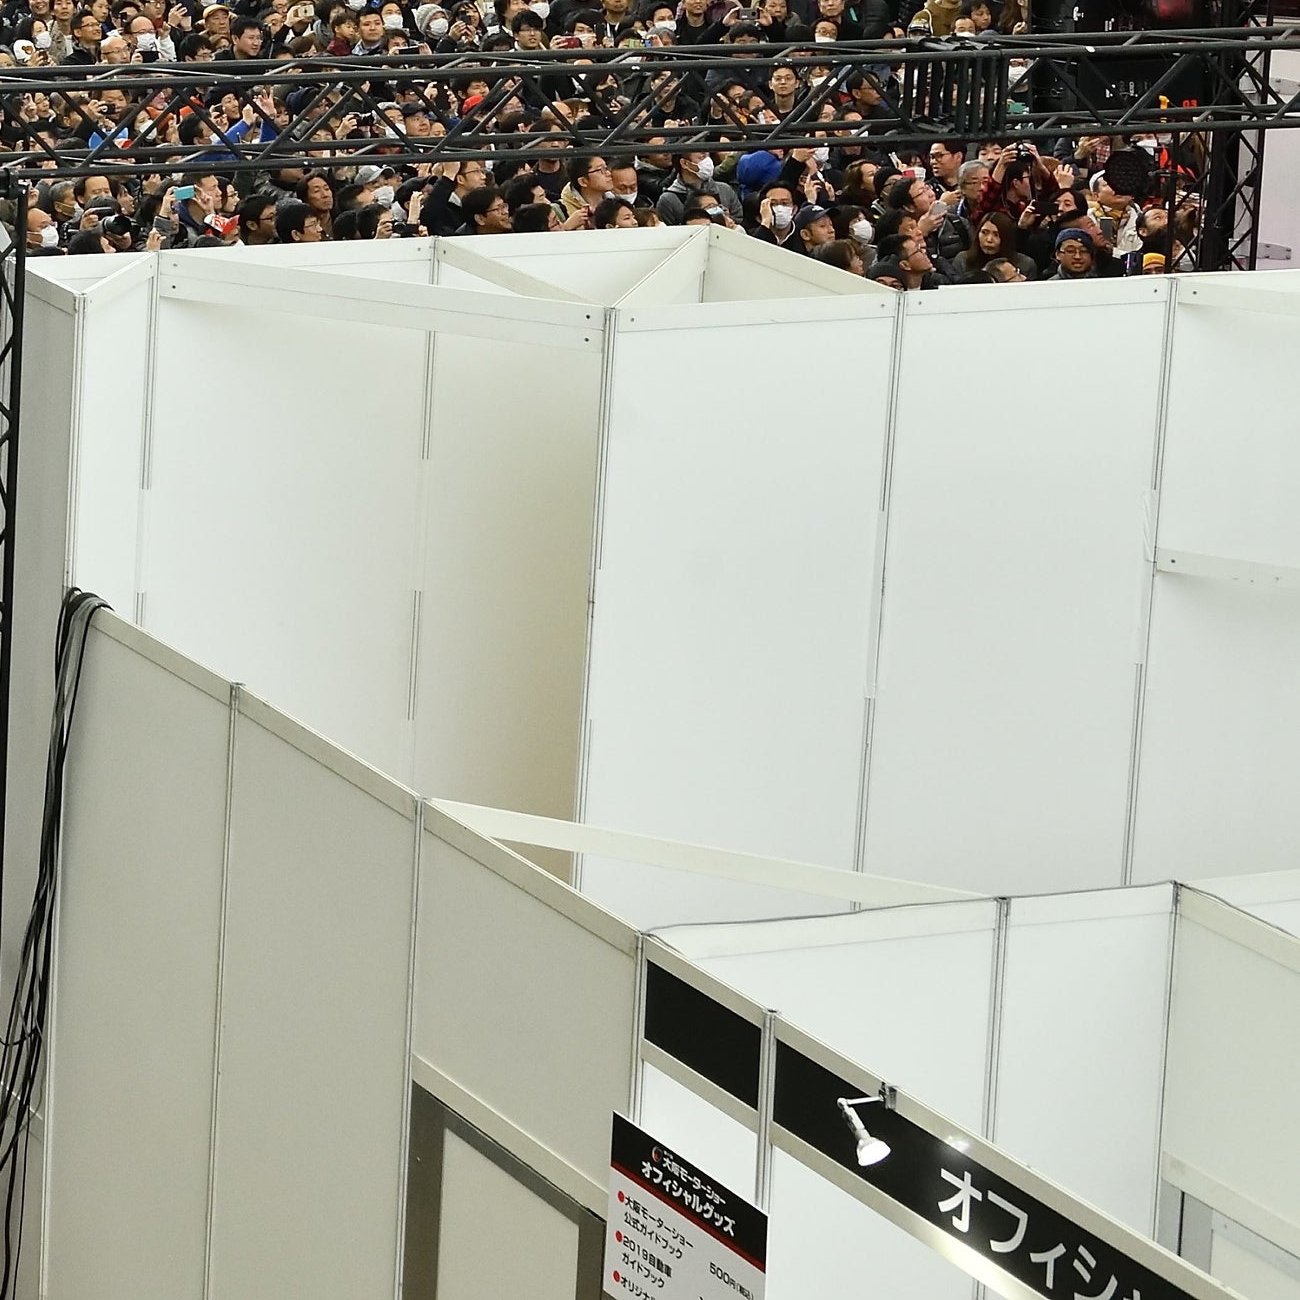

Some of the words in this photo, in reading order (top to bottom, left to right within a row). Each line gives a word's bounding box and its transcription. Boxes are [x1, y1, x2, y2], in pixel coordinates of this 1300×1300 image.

[641, 1160, 736, 1238] オフィシャルグッズ
[662, 1156, 726, 1205] 大阪モーターショー
[623, 1211, 683, 1260] 公式ガイドブック
[624, 1195, 694, 1249] 大阪モーターショー
[621, 1252, 666, 1289] ガイドブック
[622, 1235, 673, 1278] 2019自動車
